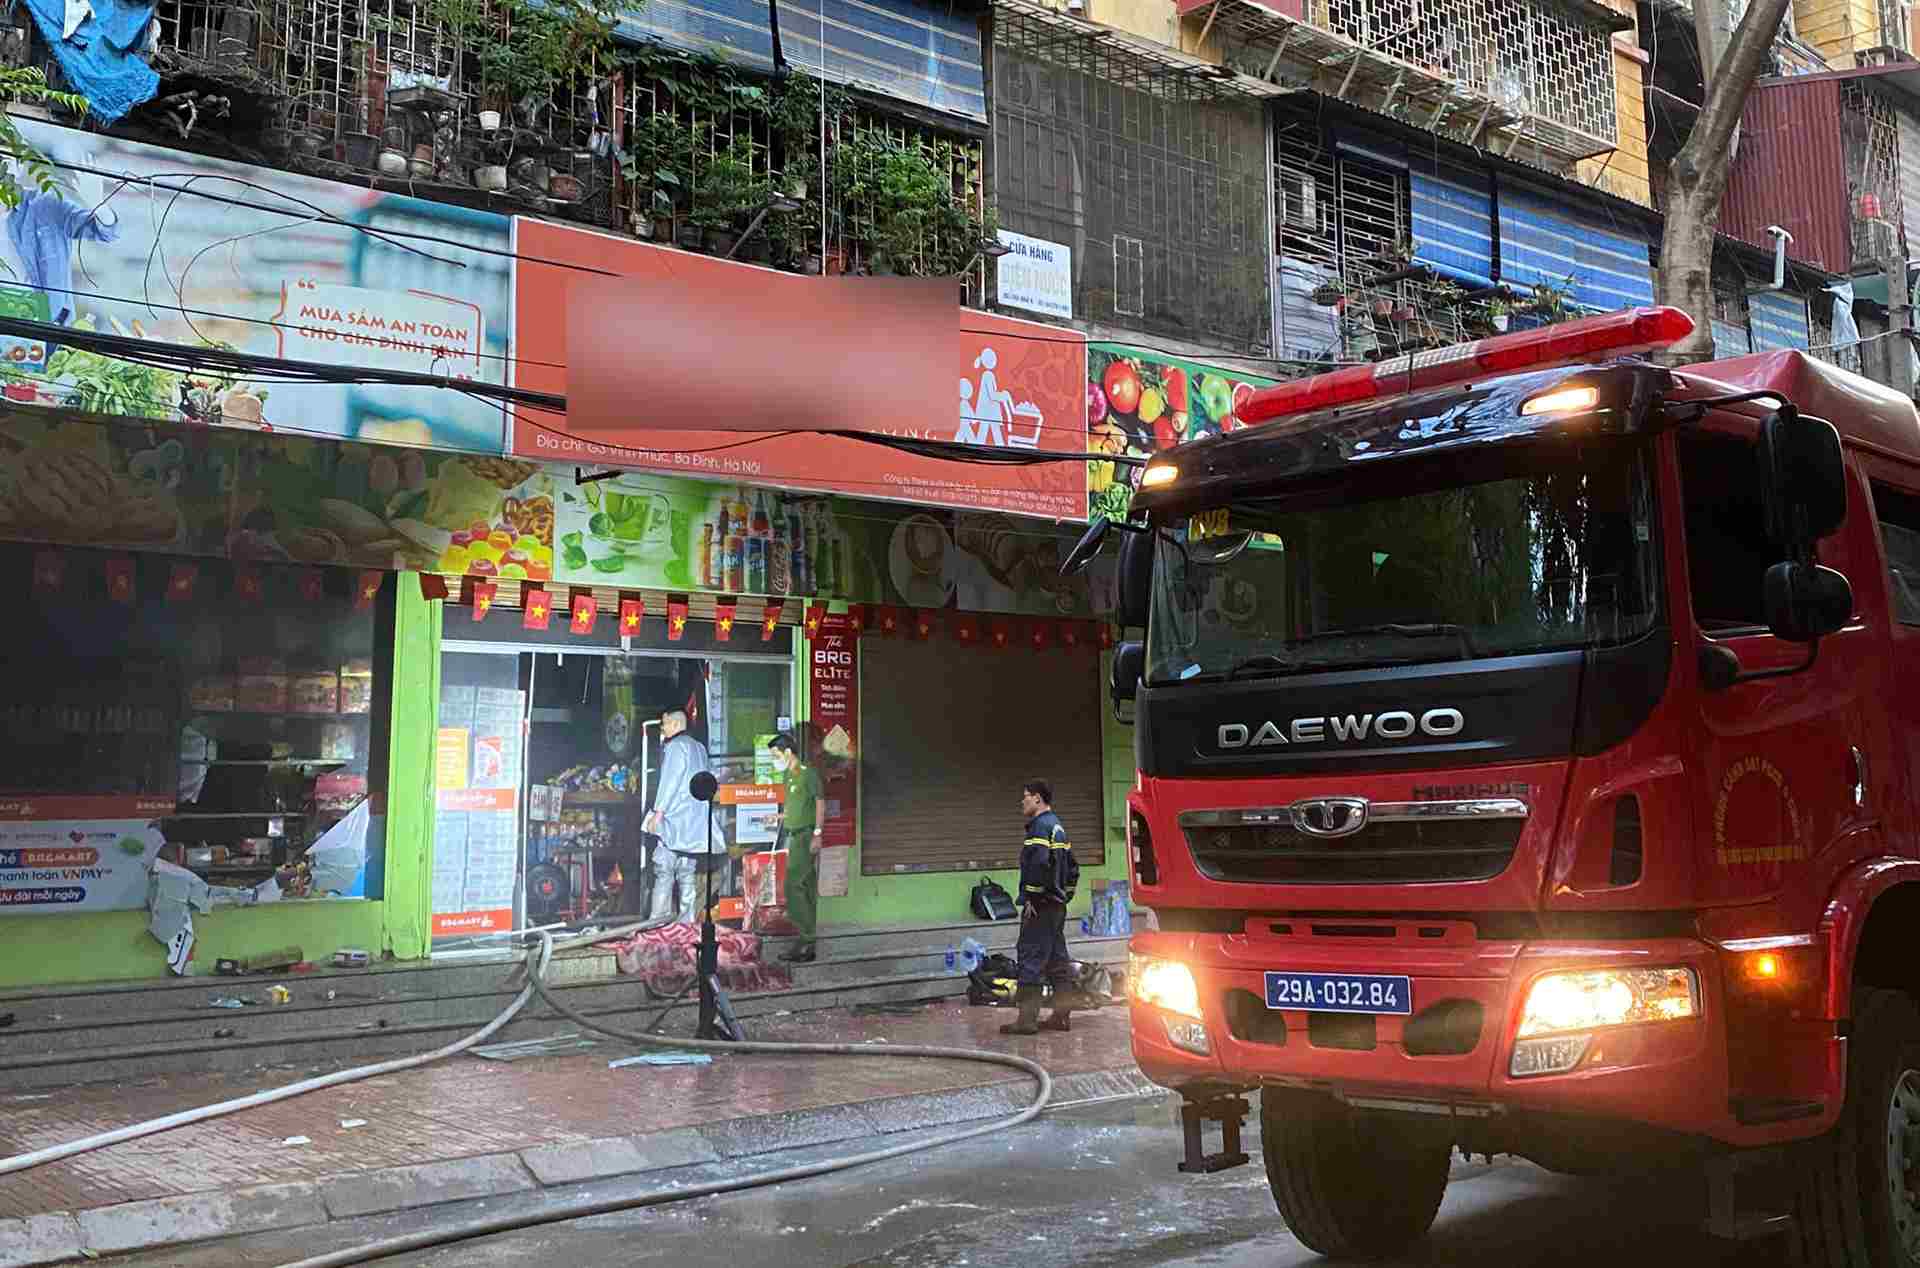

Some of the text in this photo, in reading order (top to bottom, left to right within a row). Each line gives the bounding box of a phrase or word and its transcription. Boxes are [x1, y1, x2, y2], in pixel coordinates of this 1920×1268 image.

[1029, 244, 1054, 263] HÀNG
[300, 305, 342, 322] MUA
[391, 319, 416, 333] AN
[421, 321, 467, 341] TOÀN
[300, 324, 337, 341] CHO
[343, 331, 374, 347] GIA
[824, 635, 842, 650] The
[815, 651, 851, 664] BRG
[1217, 707, 1465, 748] DAEWOO
[63, 868, 105, 880] VNPAY
[1277, 979, 1397, 1007] 29A-032.84
